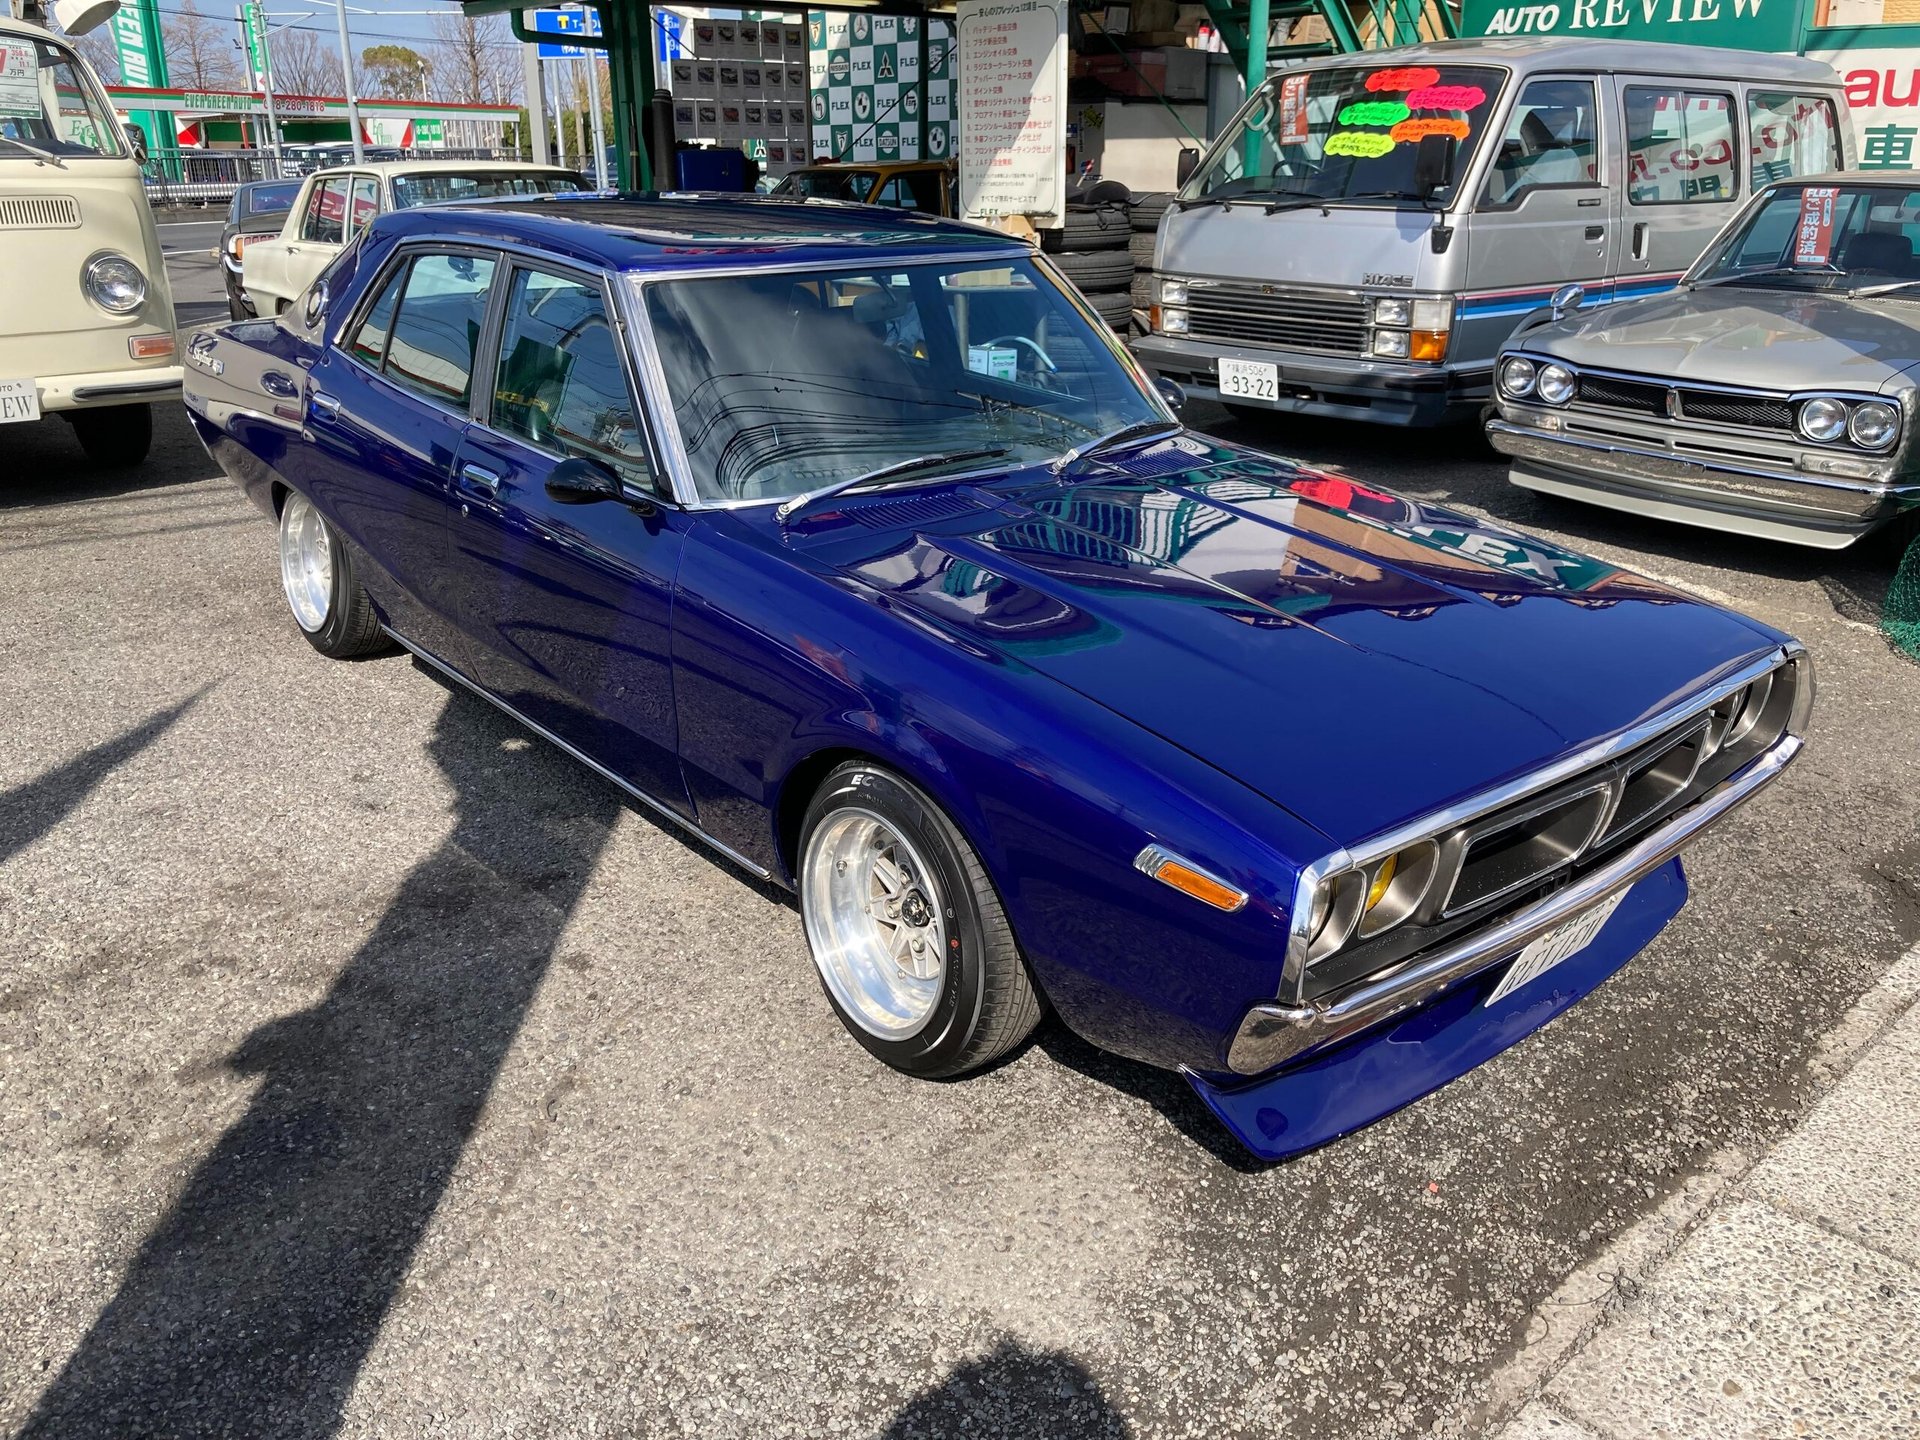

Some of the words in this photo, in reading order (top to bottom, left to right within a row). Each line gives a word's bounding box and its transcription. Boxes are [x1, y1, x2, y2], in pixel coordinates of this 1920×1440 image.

[874, 18, 894, 29] FLEX
[1484, 5, 1560, 35] AUTO
[1569, 0, 1763, 29] REVIEW
[828, 24, 847, 33] FLEX
[9, 68, 25, 76] 万円
[852, 61, 872, 71] FLEX
[1842, 69, 1920, 107] au
[263, 98, 326, 112] 08-280-1818
[831, 101, 850, 111] FLEX
[876, 98, 897, 108] FLEX
[855, 138, 874, 147] FLEX
[1858, 123, 1919, 171] 車
[1806, 187, 1833, 198] FLEX
[1799, 198, 1821, 255] ご成約済
[1362, 272, 1414, 287] HIACE
[1232, 375, 1274, 398] 93-22
[1496, 911, 1613, 999] REVIEW
